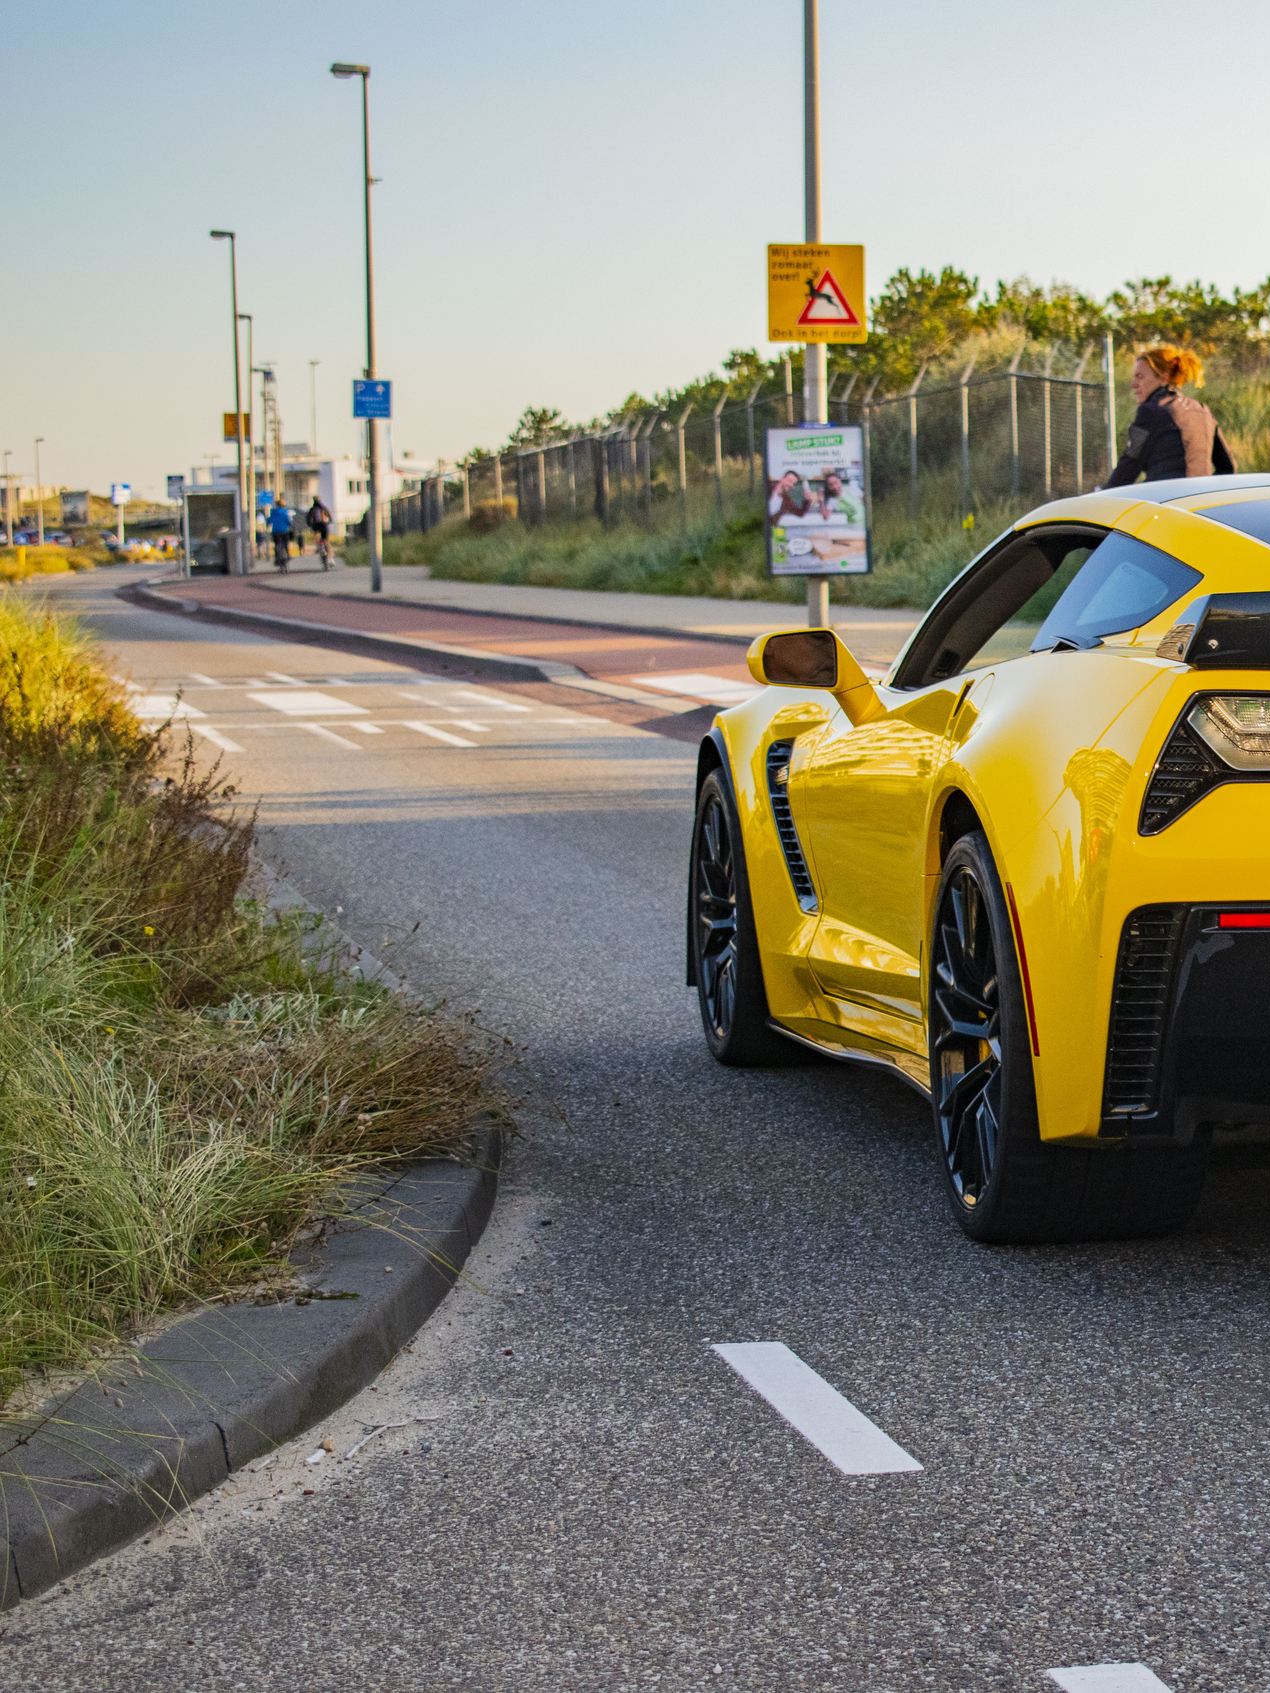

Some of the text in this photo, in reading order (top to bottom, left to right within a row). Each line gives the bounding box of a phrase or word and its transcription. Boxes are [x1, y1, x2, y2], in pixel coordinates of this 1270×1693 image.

[771, 248, 830, 259] Wij steken
[772, 261, 813, 269] zomaar
[772, 272, 800, 281] over!
[772, 329, 792, 337] Ook
[797, 329, 808, 337] in
[811, 329, 829, 337] het
